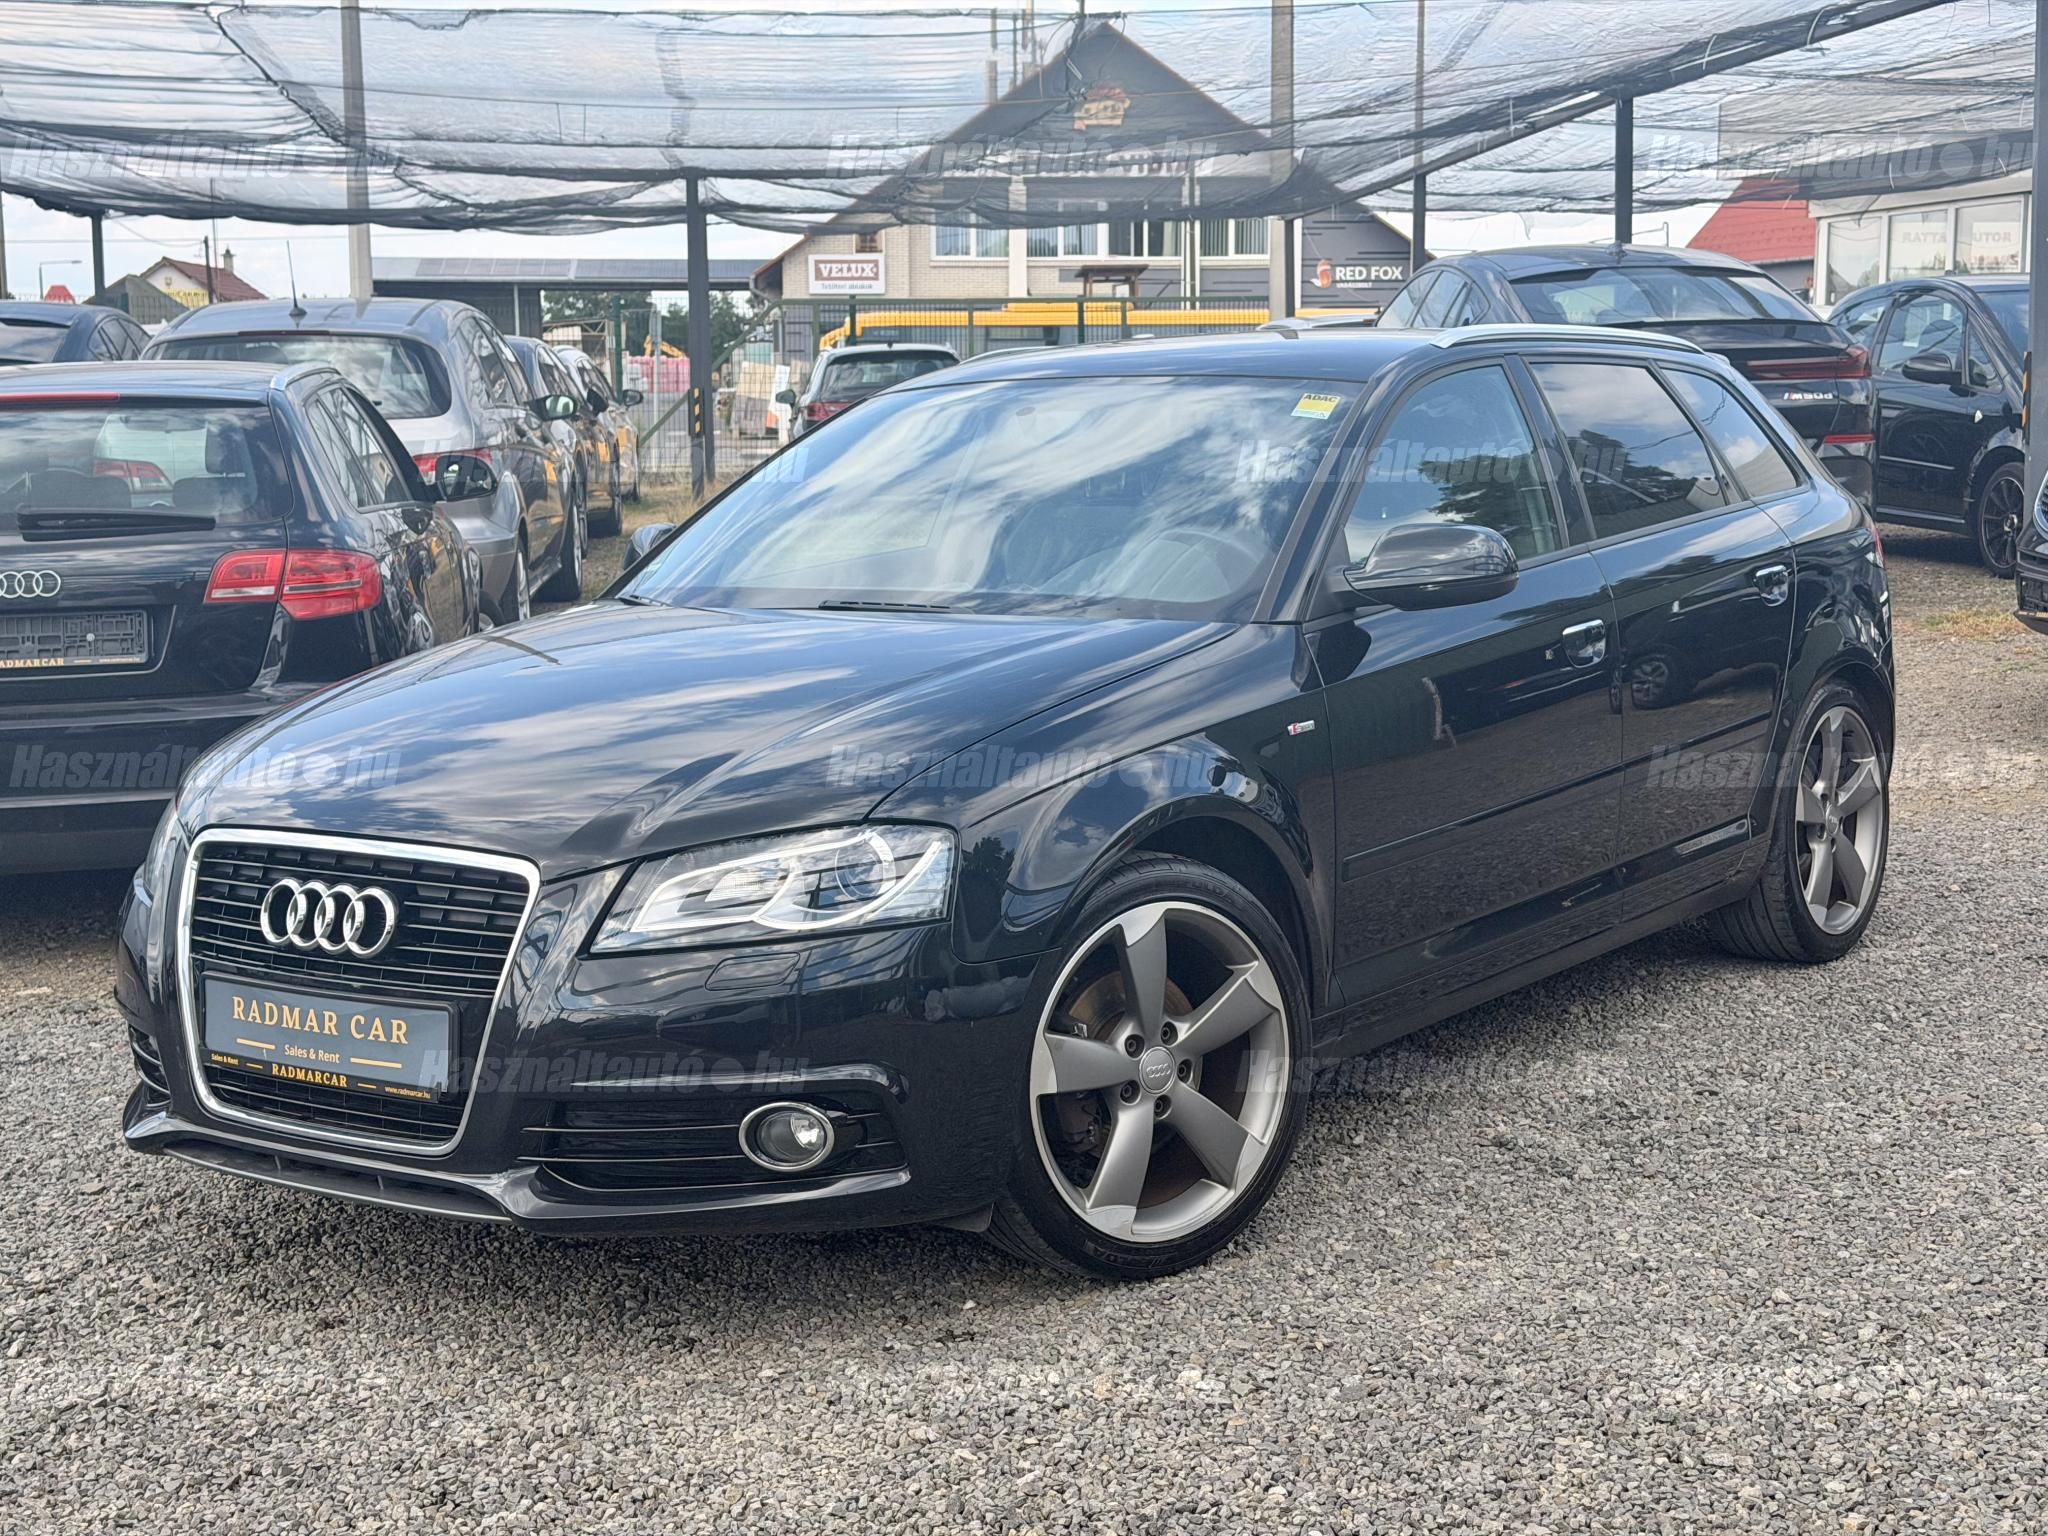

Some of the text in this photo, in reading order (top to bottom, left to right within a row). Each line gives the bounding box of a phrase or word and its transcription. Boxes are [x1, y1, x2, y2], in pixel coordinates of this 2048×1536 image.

[1902, 231, 1948, 244] RATTA
[819, 263, 877, 277] VELUX
[1335, 266, 1403, 280] RED FOX
[1303, 394, 1338, 402] ADAC
[0, 658, 65, 669] ADMARCAR
[232, 996, 408, 1044] RADMAR CAR
[284, 1044, 340, 1063] Sales & Rent
[211, 1053, 223, 1062] Sales
[227, 1056, 239, 1065] Rent
[271, 1063, 347, 1087] RADMARCAR
